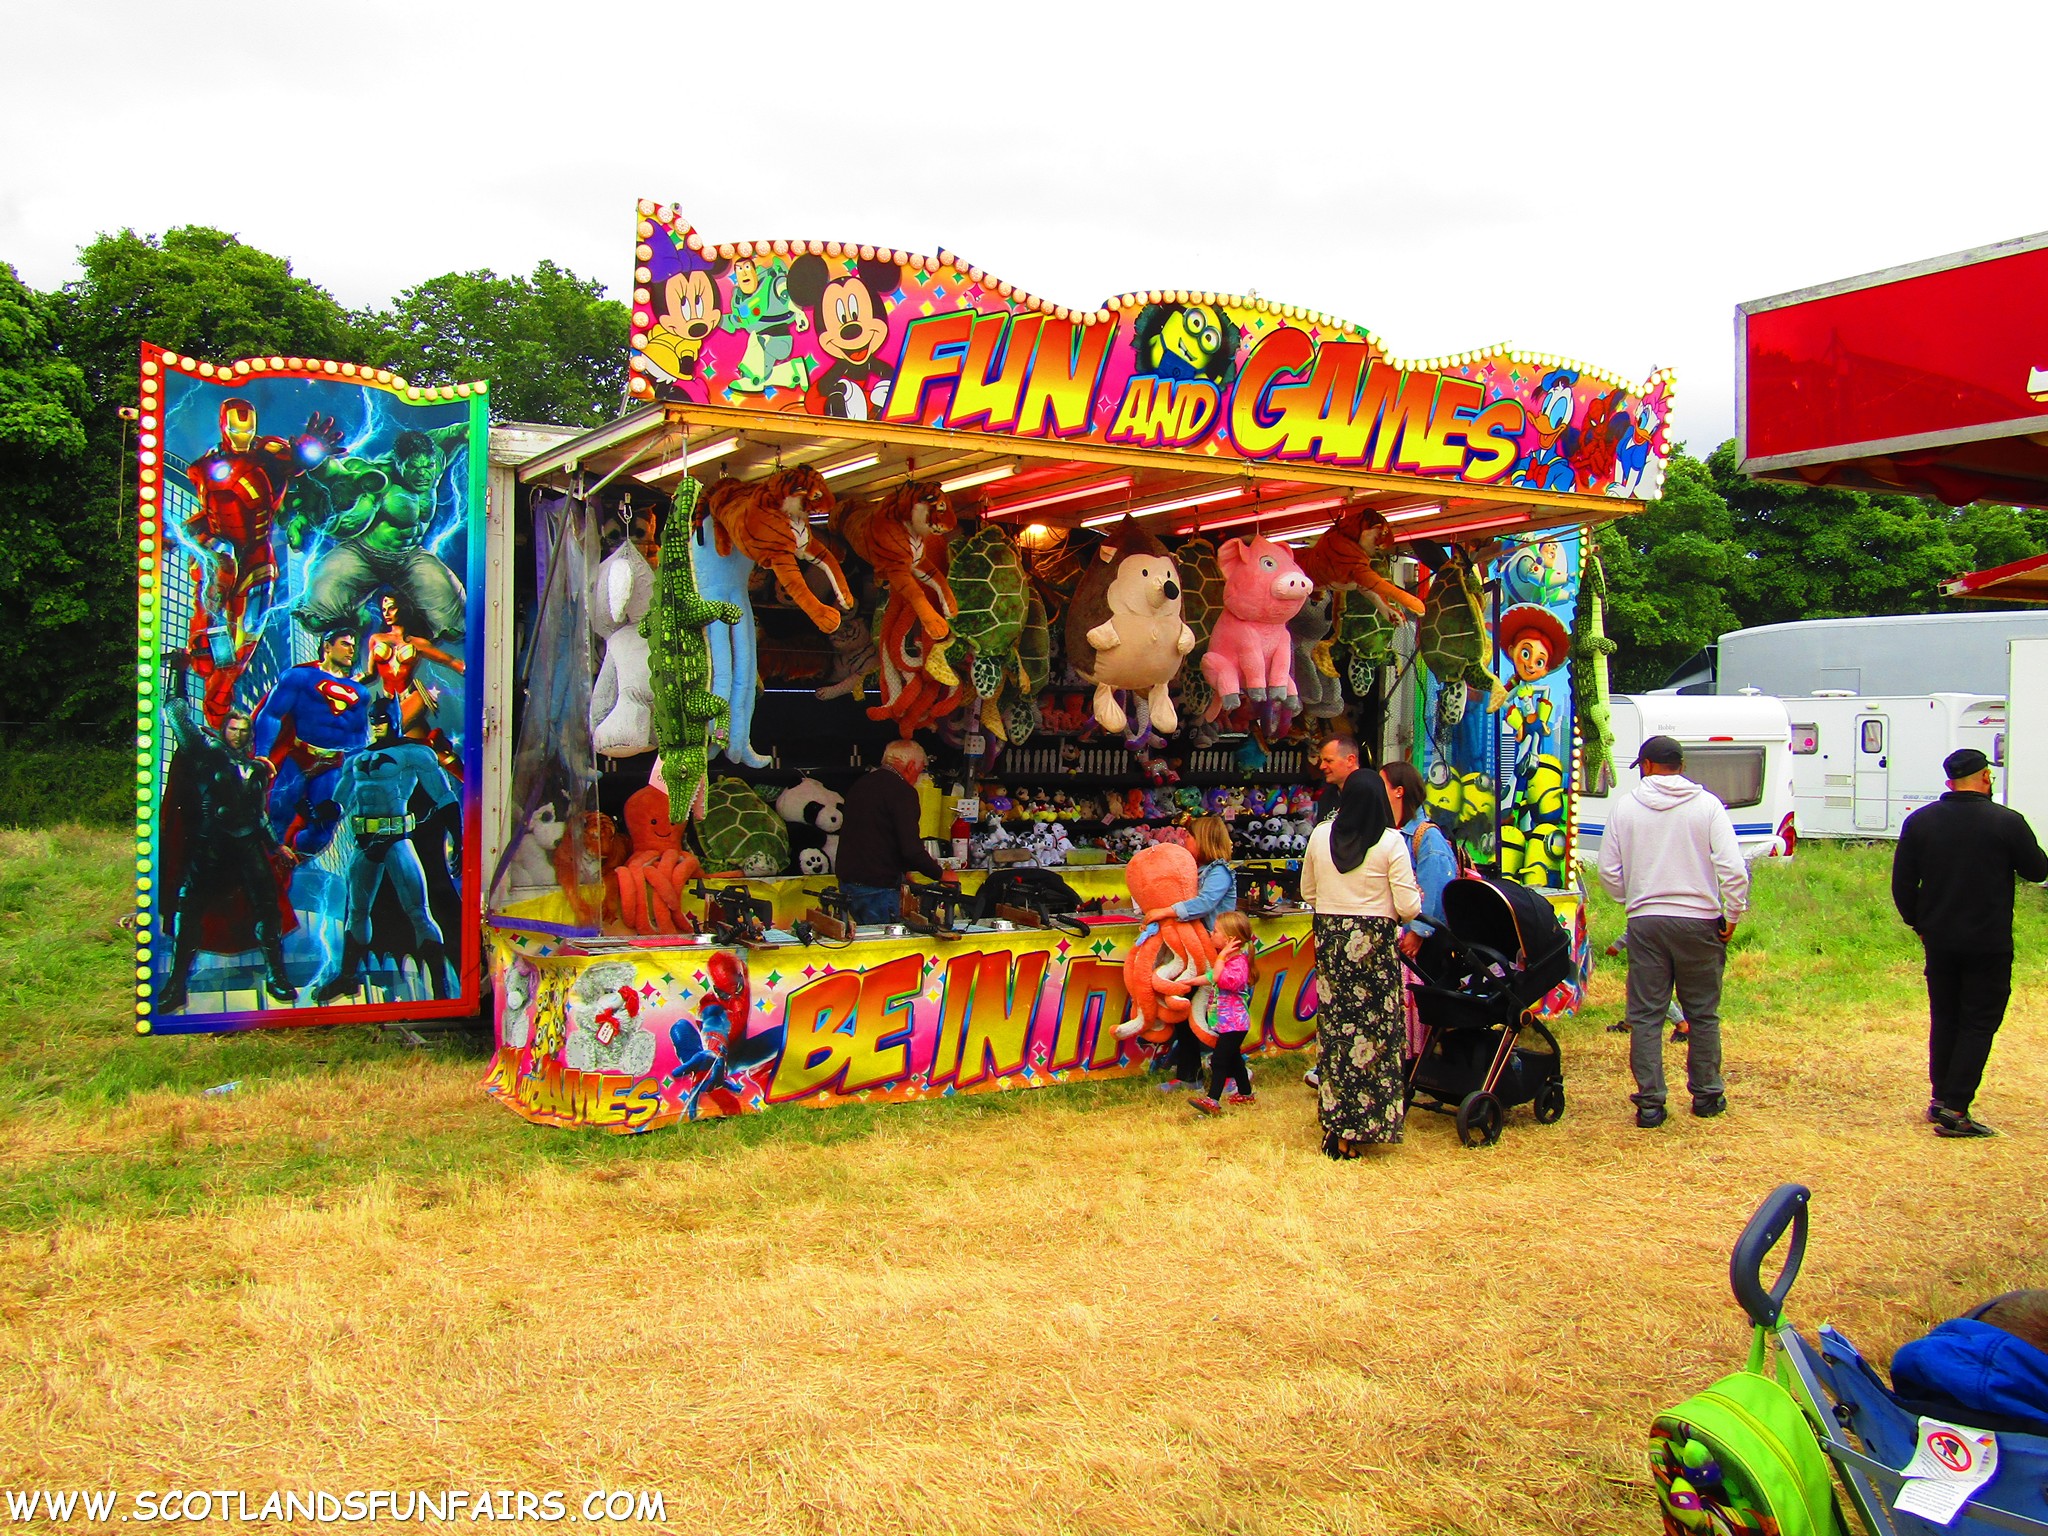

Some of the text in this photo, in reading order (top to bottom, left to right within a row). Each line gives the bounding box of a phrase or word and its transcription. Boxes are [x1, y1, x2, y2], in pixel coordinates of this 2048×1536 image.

[884, 309, 1527, 482] FUN AND GAMES
[766, 953, 925, 1105] BE
[929, 950, 1050, 1090] IN
